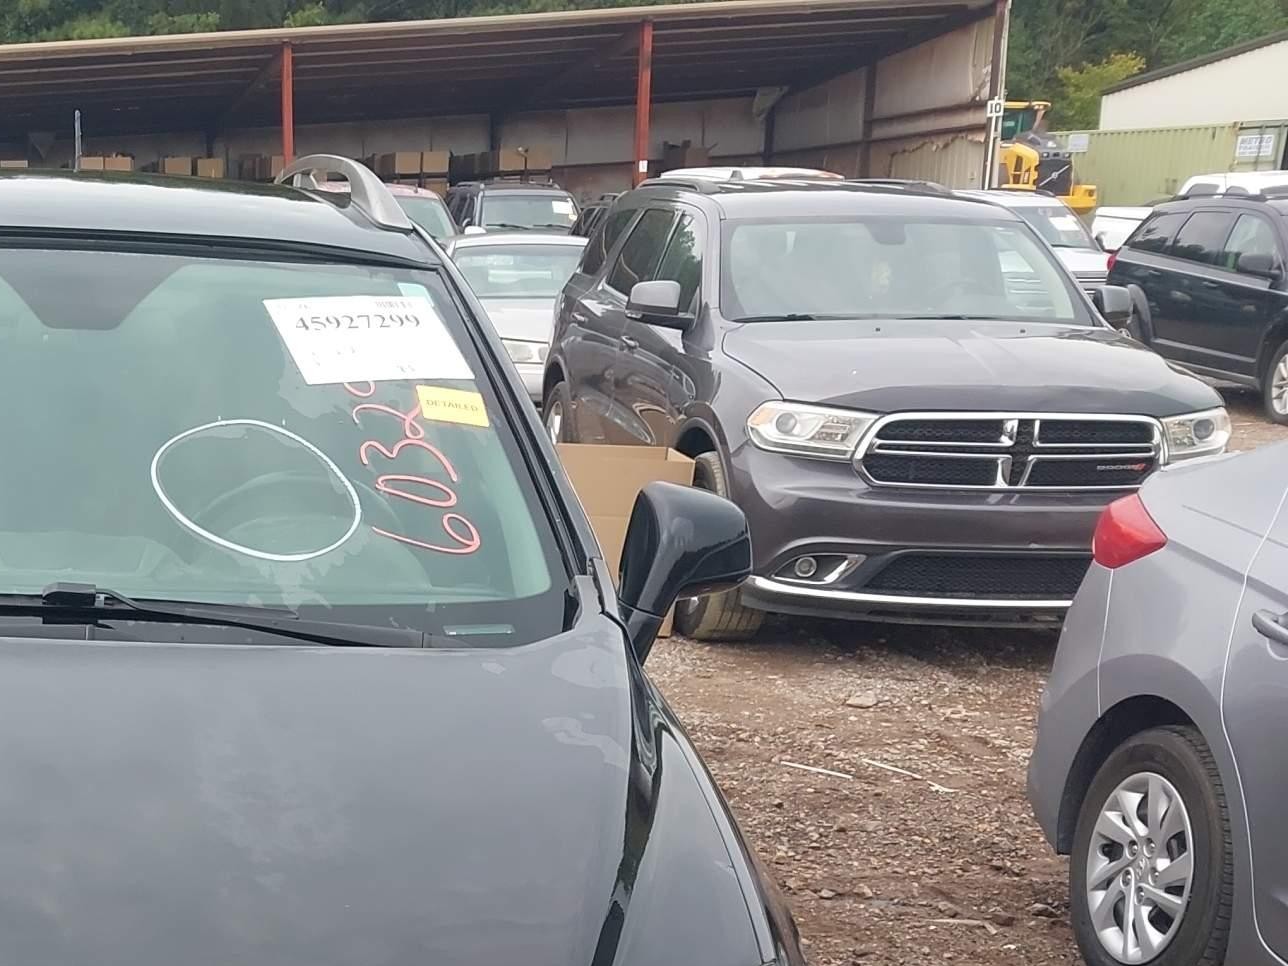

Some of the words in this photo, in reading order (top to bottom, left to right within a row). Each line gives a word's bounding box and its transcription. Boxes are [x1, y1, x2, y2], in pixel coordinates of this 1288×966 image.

[989, 102, 1002, 115] 10
[295, 313, 420, 331] 45927299
[425, 399, 480, 413] DETAILED
